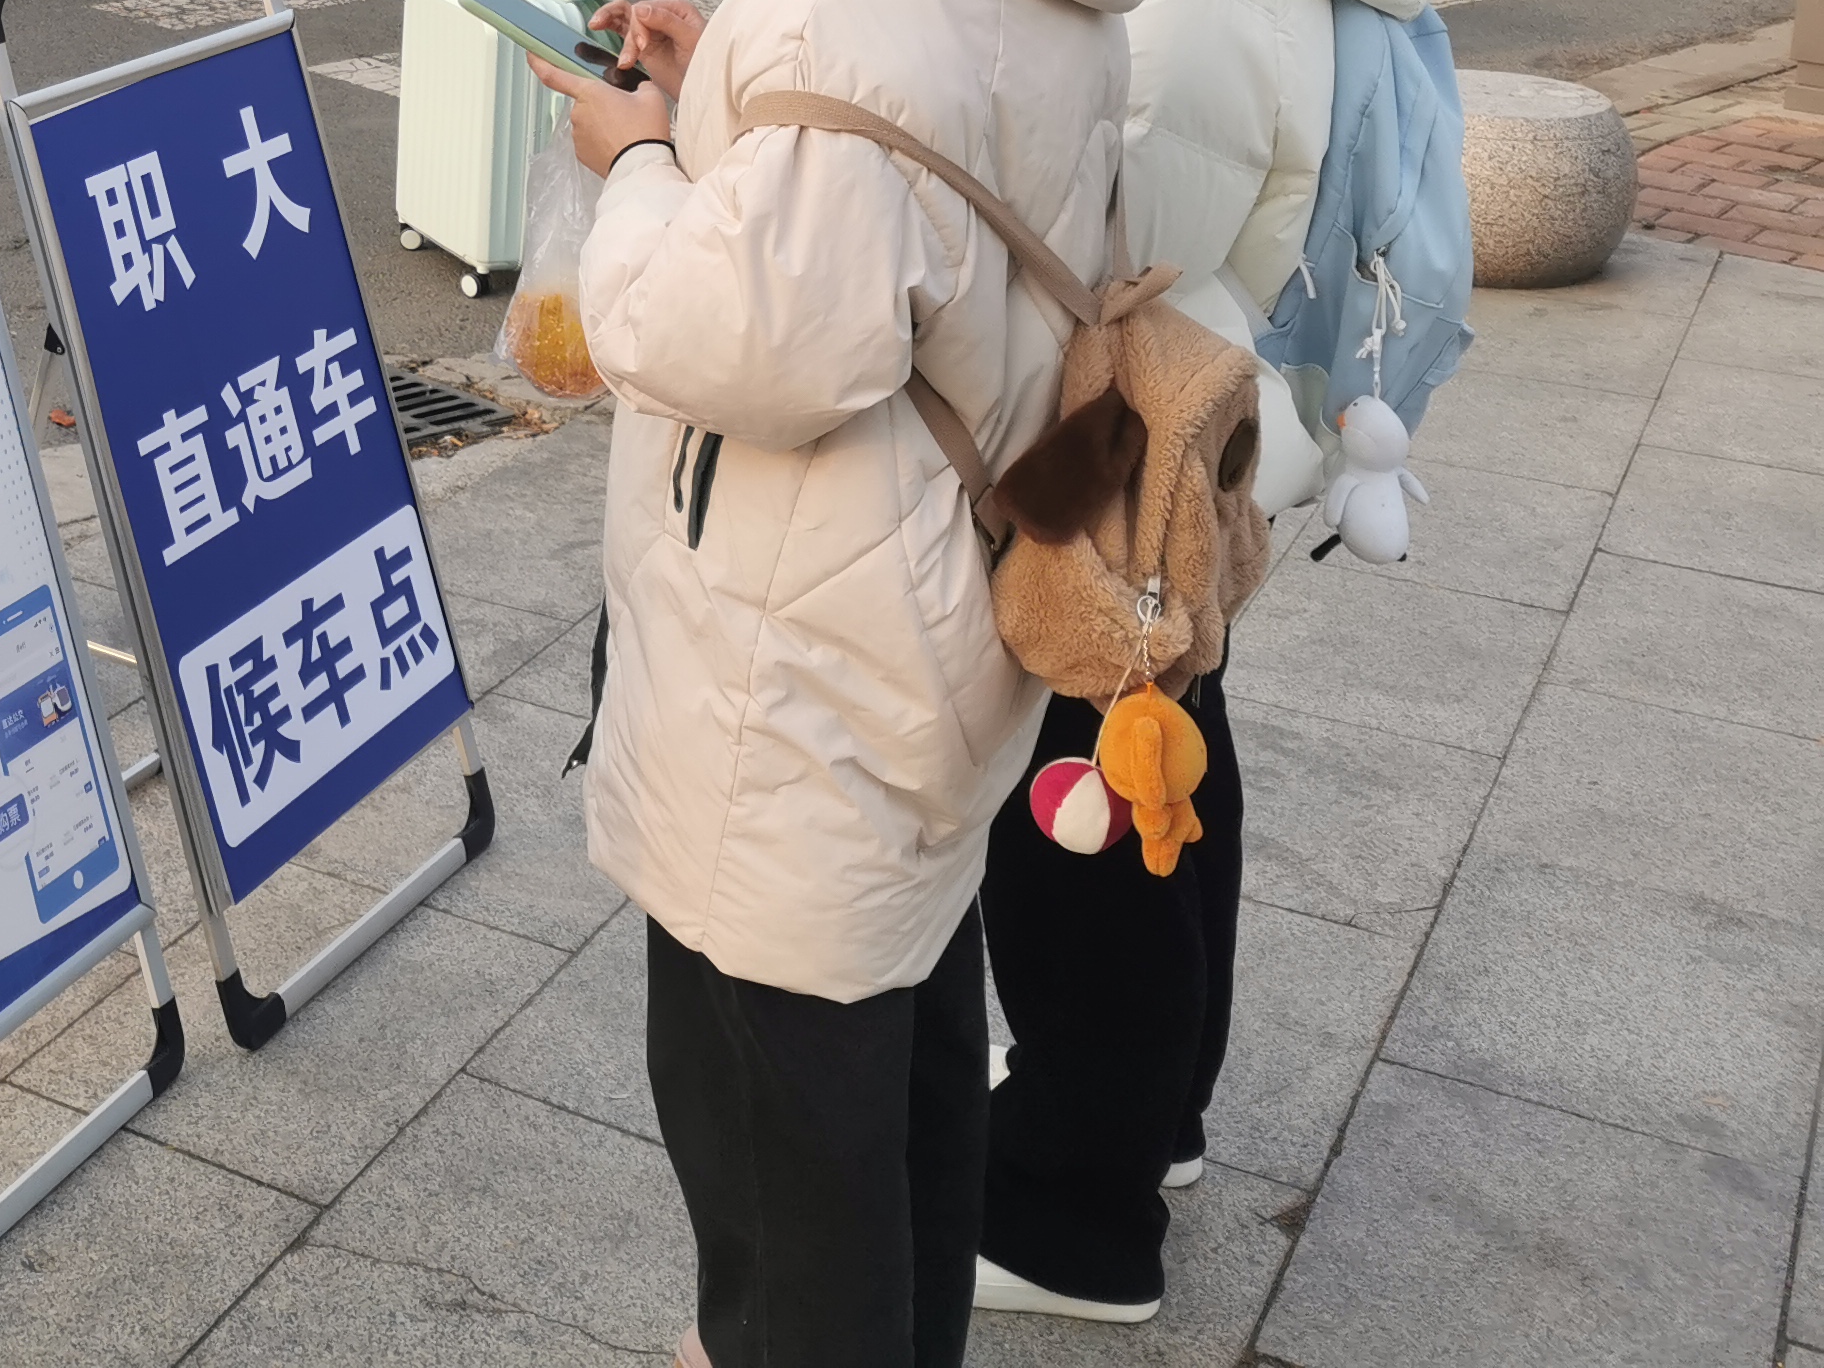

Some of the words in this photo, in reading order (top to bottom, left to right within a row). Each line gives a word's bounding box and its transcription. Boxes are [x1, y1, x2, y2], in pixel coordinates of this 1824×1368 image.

[136, 327, 377, 567] 直通车
[206, 544, 440, 810] 候车点
